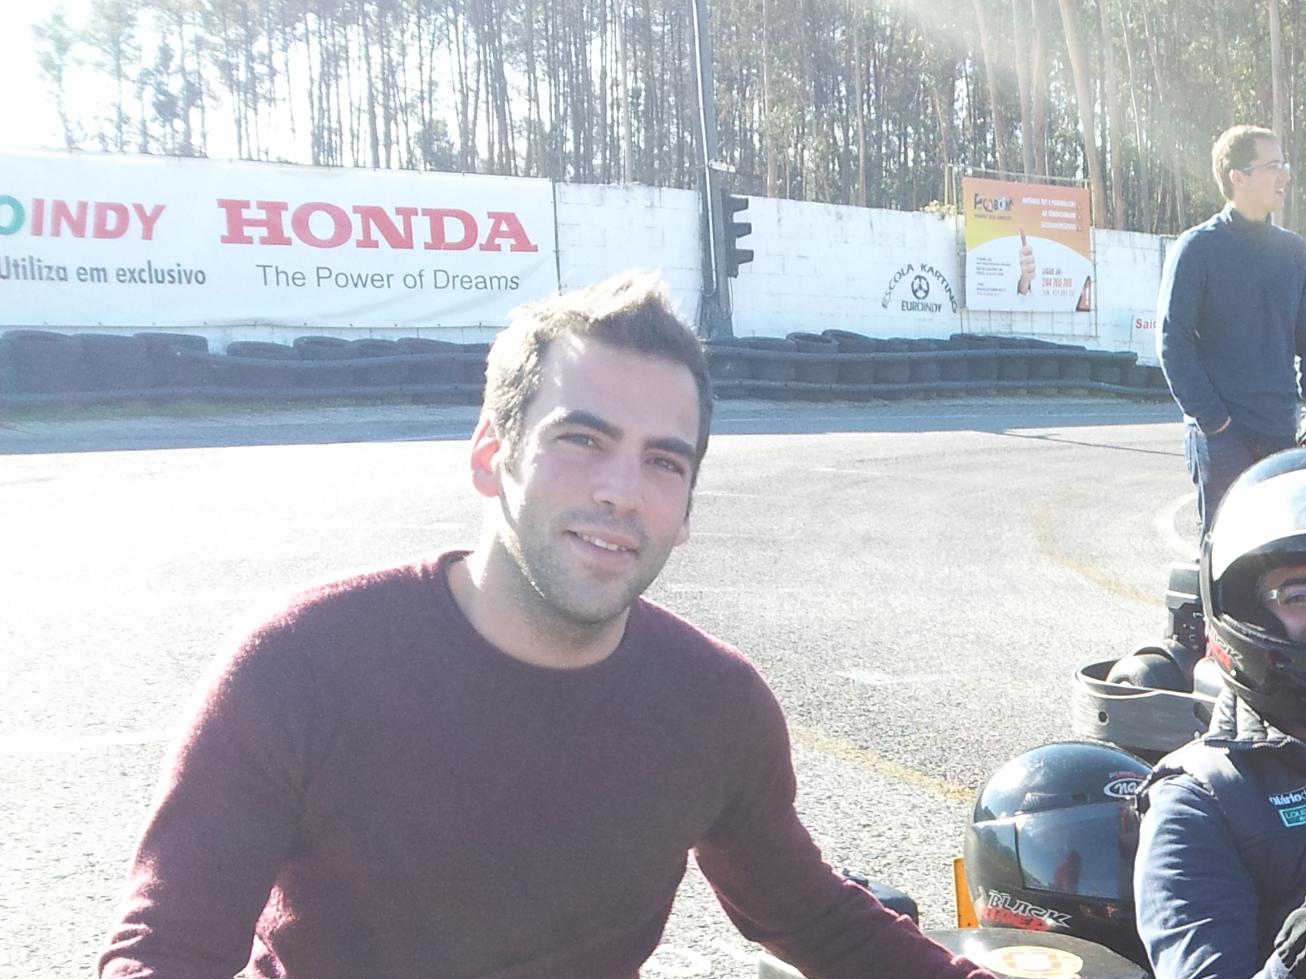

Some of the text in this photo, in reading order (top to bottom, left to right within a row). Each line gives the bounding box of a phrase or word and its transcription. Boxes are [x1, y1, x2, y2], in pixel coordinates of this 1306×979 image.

[217, 198, 538, 253] HONDA
[76, 265, 108, 283] em
[116, 260, 206, 285] exclusivo
[256, 264, 520, 291] The Power of Dreams
[881, 262, 958, 314] ESCOLA KARTING
[901, 300, 942, 313] EUROINDY
[988, 890, 1072, 928] BLACK
